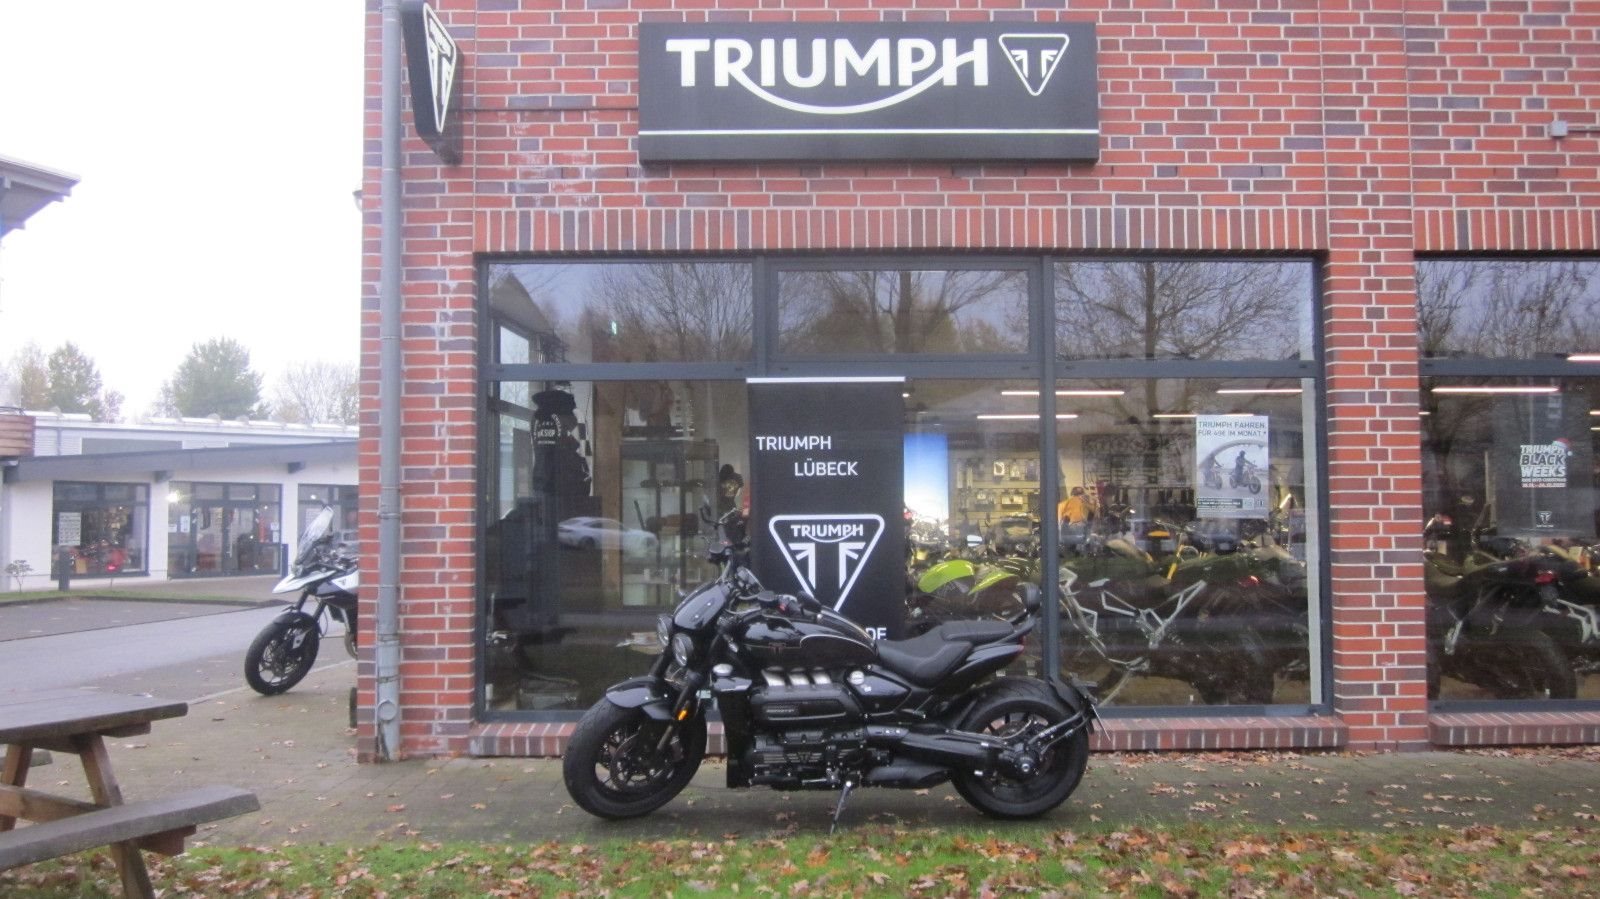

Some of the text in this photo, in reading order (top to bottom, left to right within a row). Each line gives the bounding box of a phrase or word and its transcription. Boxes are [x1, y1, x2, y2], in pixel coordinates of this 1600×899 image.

[665, 37, 989, 115] TRIUMPH
[1198, 421, 1265, 429] TRIUMPH FAHREN
[755, 436, 832, 450] TRIUMPH
[1520, 444, 1565, 454] TRIUMPH
[1521, 454, 1565, 465] BLACK
[794, 458, 858, 476] LÜBECK
[1520, 466, 1566, 477] WEEKS
[791, 524, 864, 542] TRIUMPH
